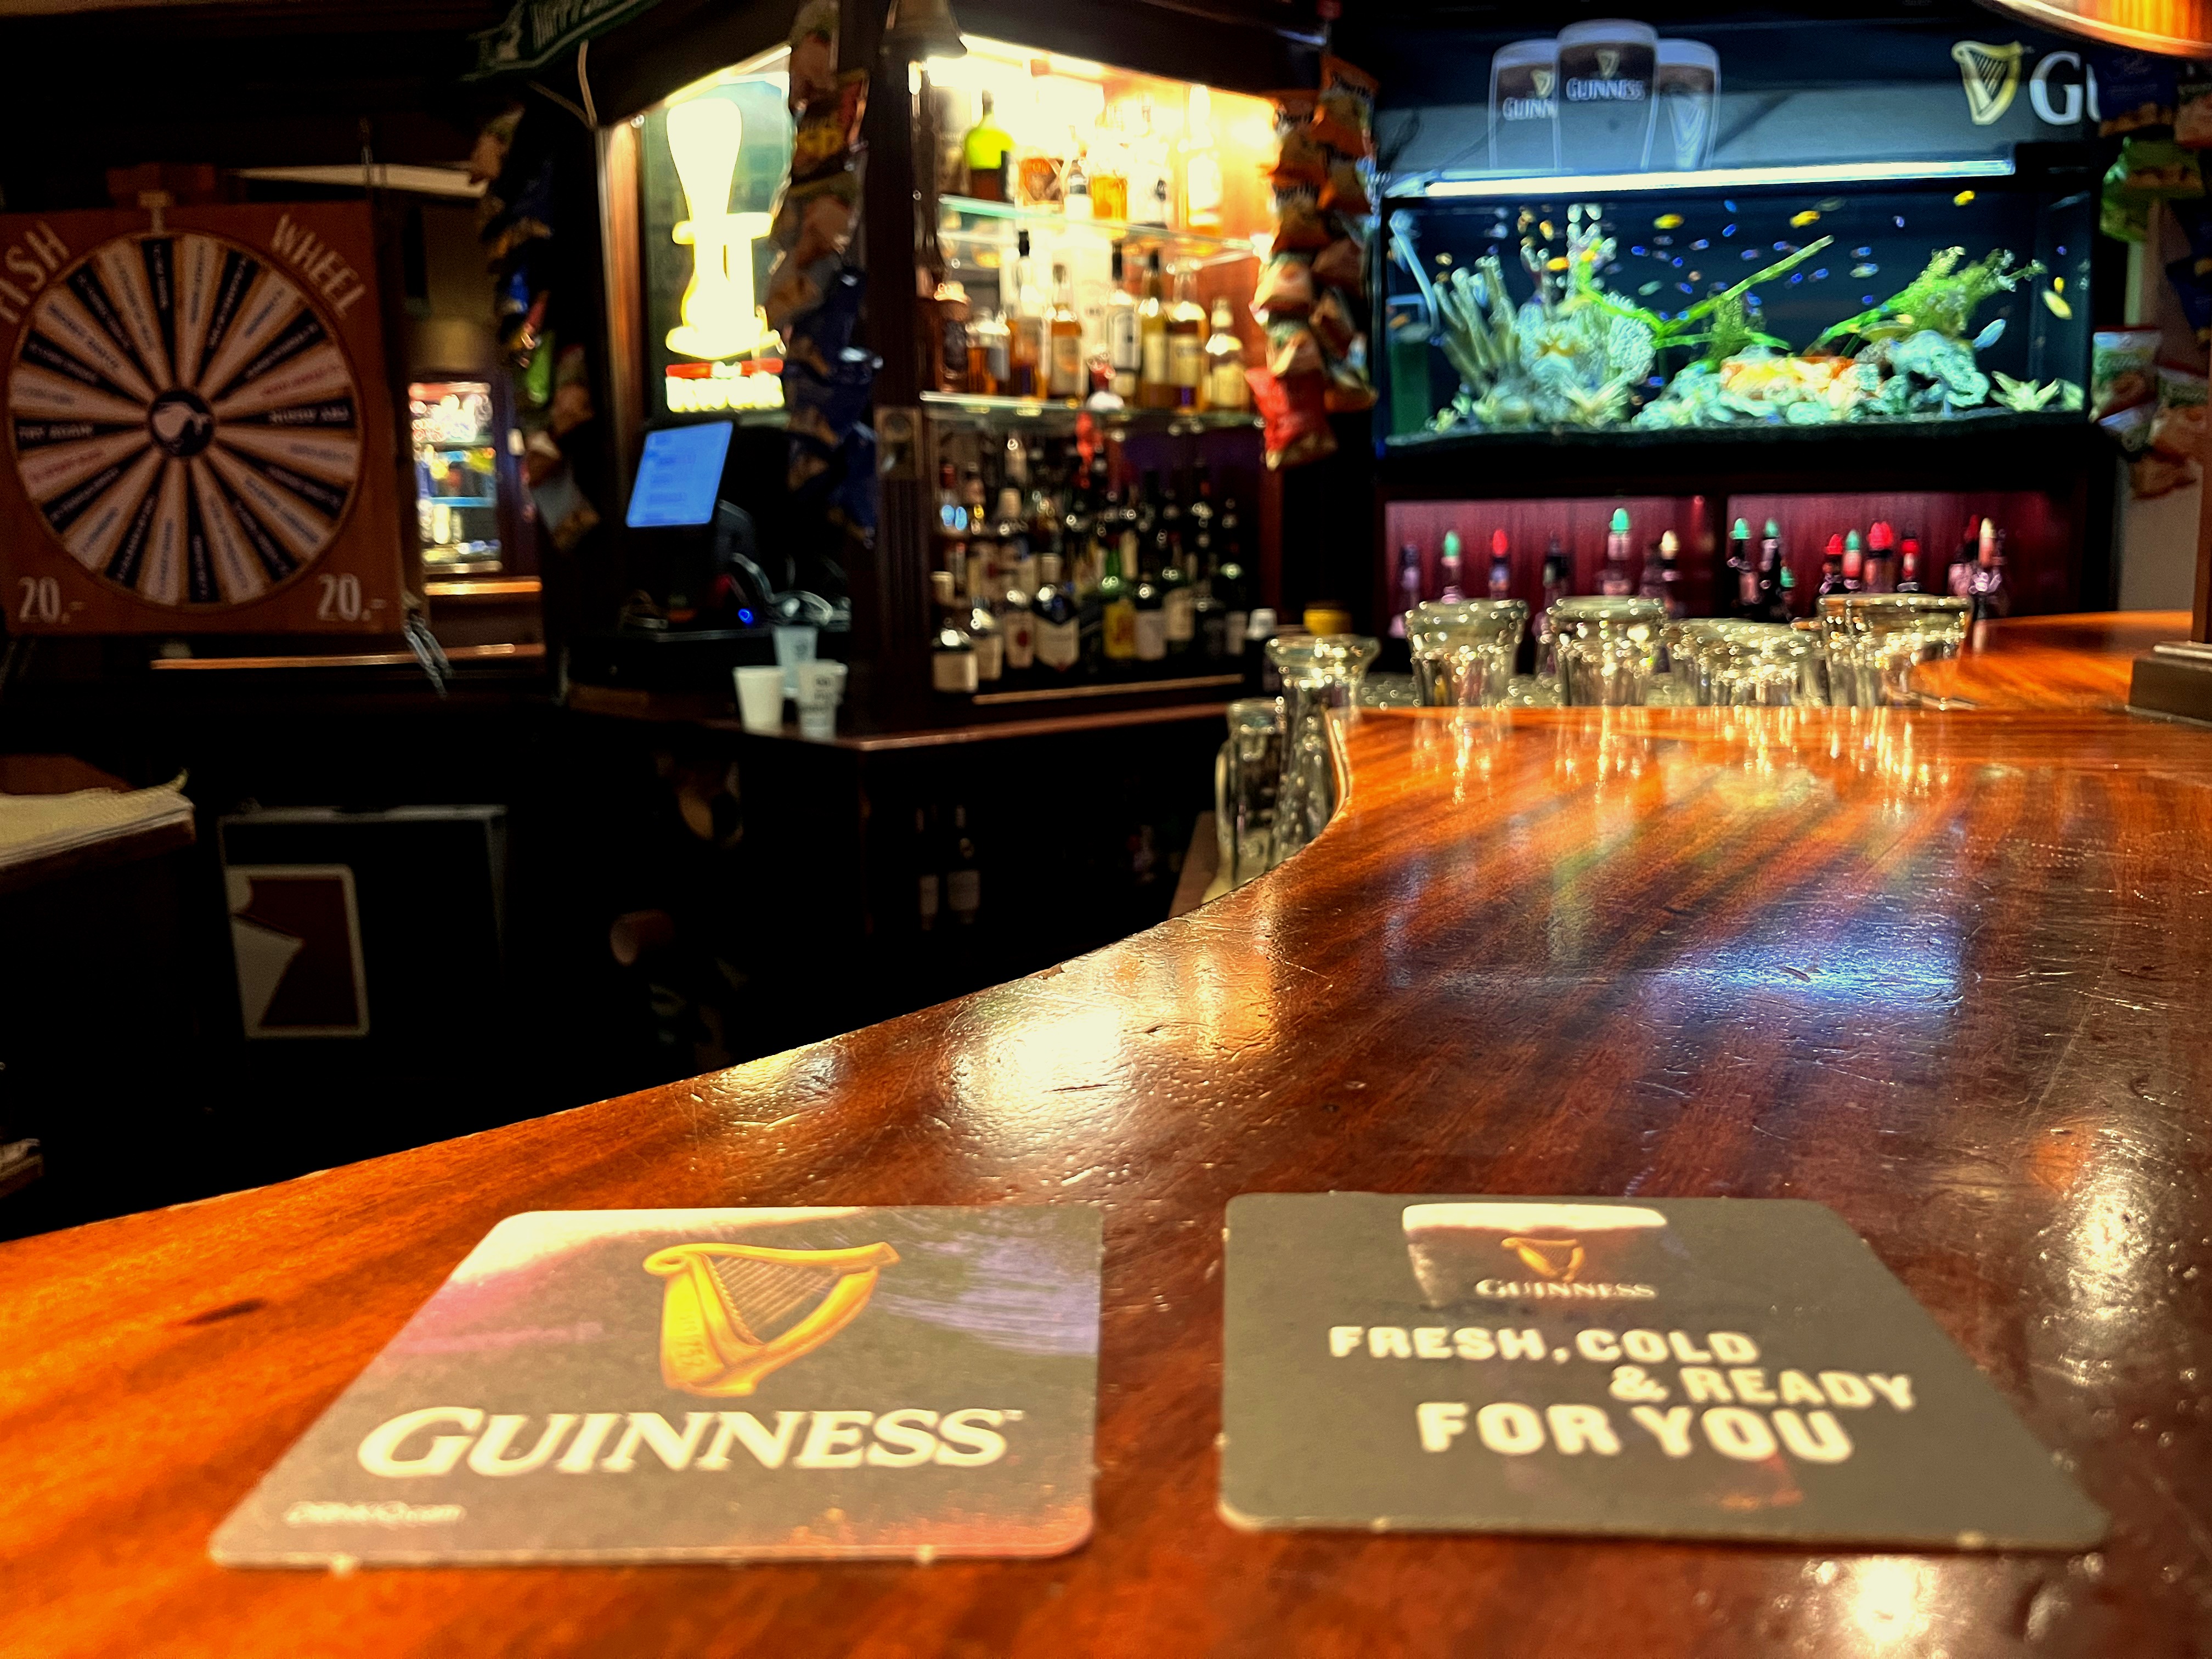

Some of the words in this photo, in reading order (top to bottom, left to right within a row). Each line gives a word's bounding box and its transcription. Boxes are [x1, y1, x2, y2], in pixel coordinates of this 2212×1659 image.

[272, 214, 365, 319] WHEEL
[1476, 1279, 1657, 1300] GUINNESS
[1609, 1365, 1669, 1402] &
[1679, 1367, 1914, 1410] READY
[357, 1406, 1007, 1477] GUINNESS
[1415, 1401, 1622, 1456] FOR
[1630, 1405, 1853, 1464] YOU
